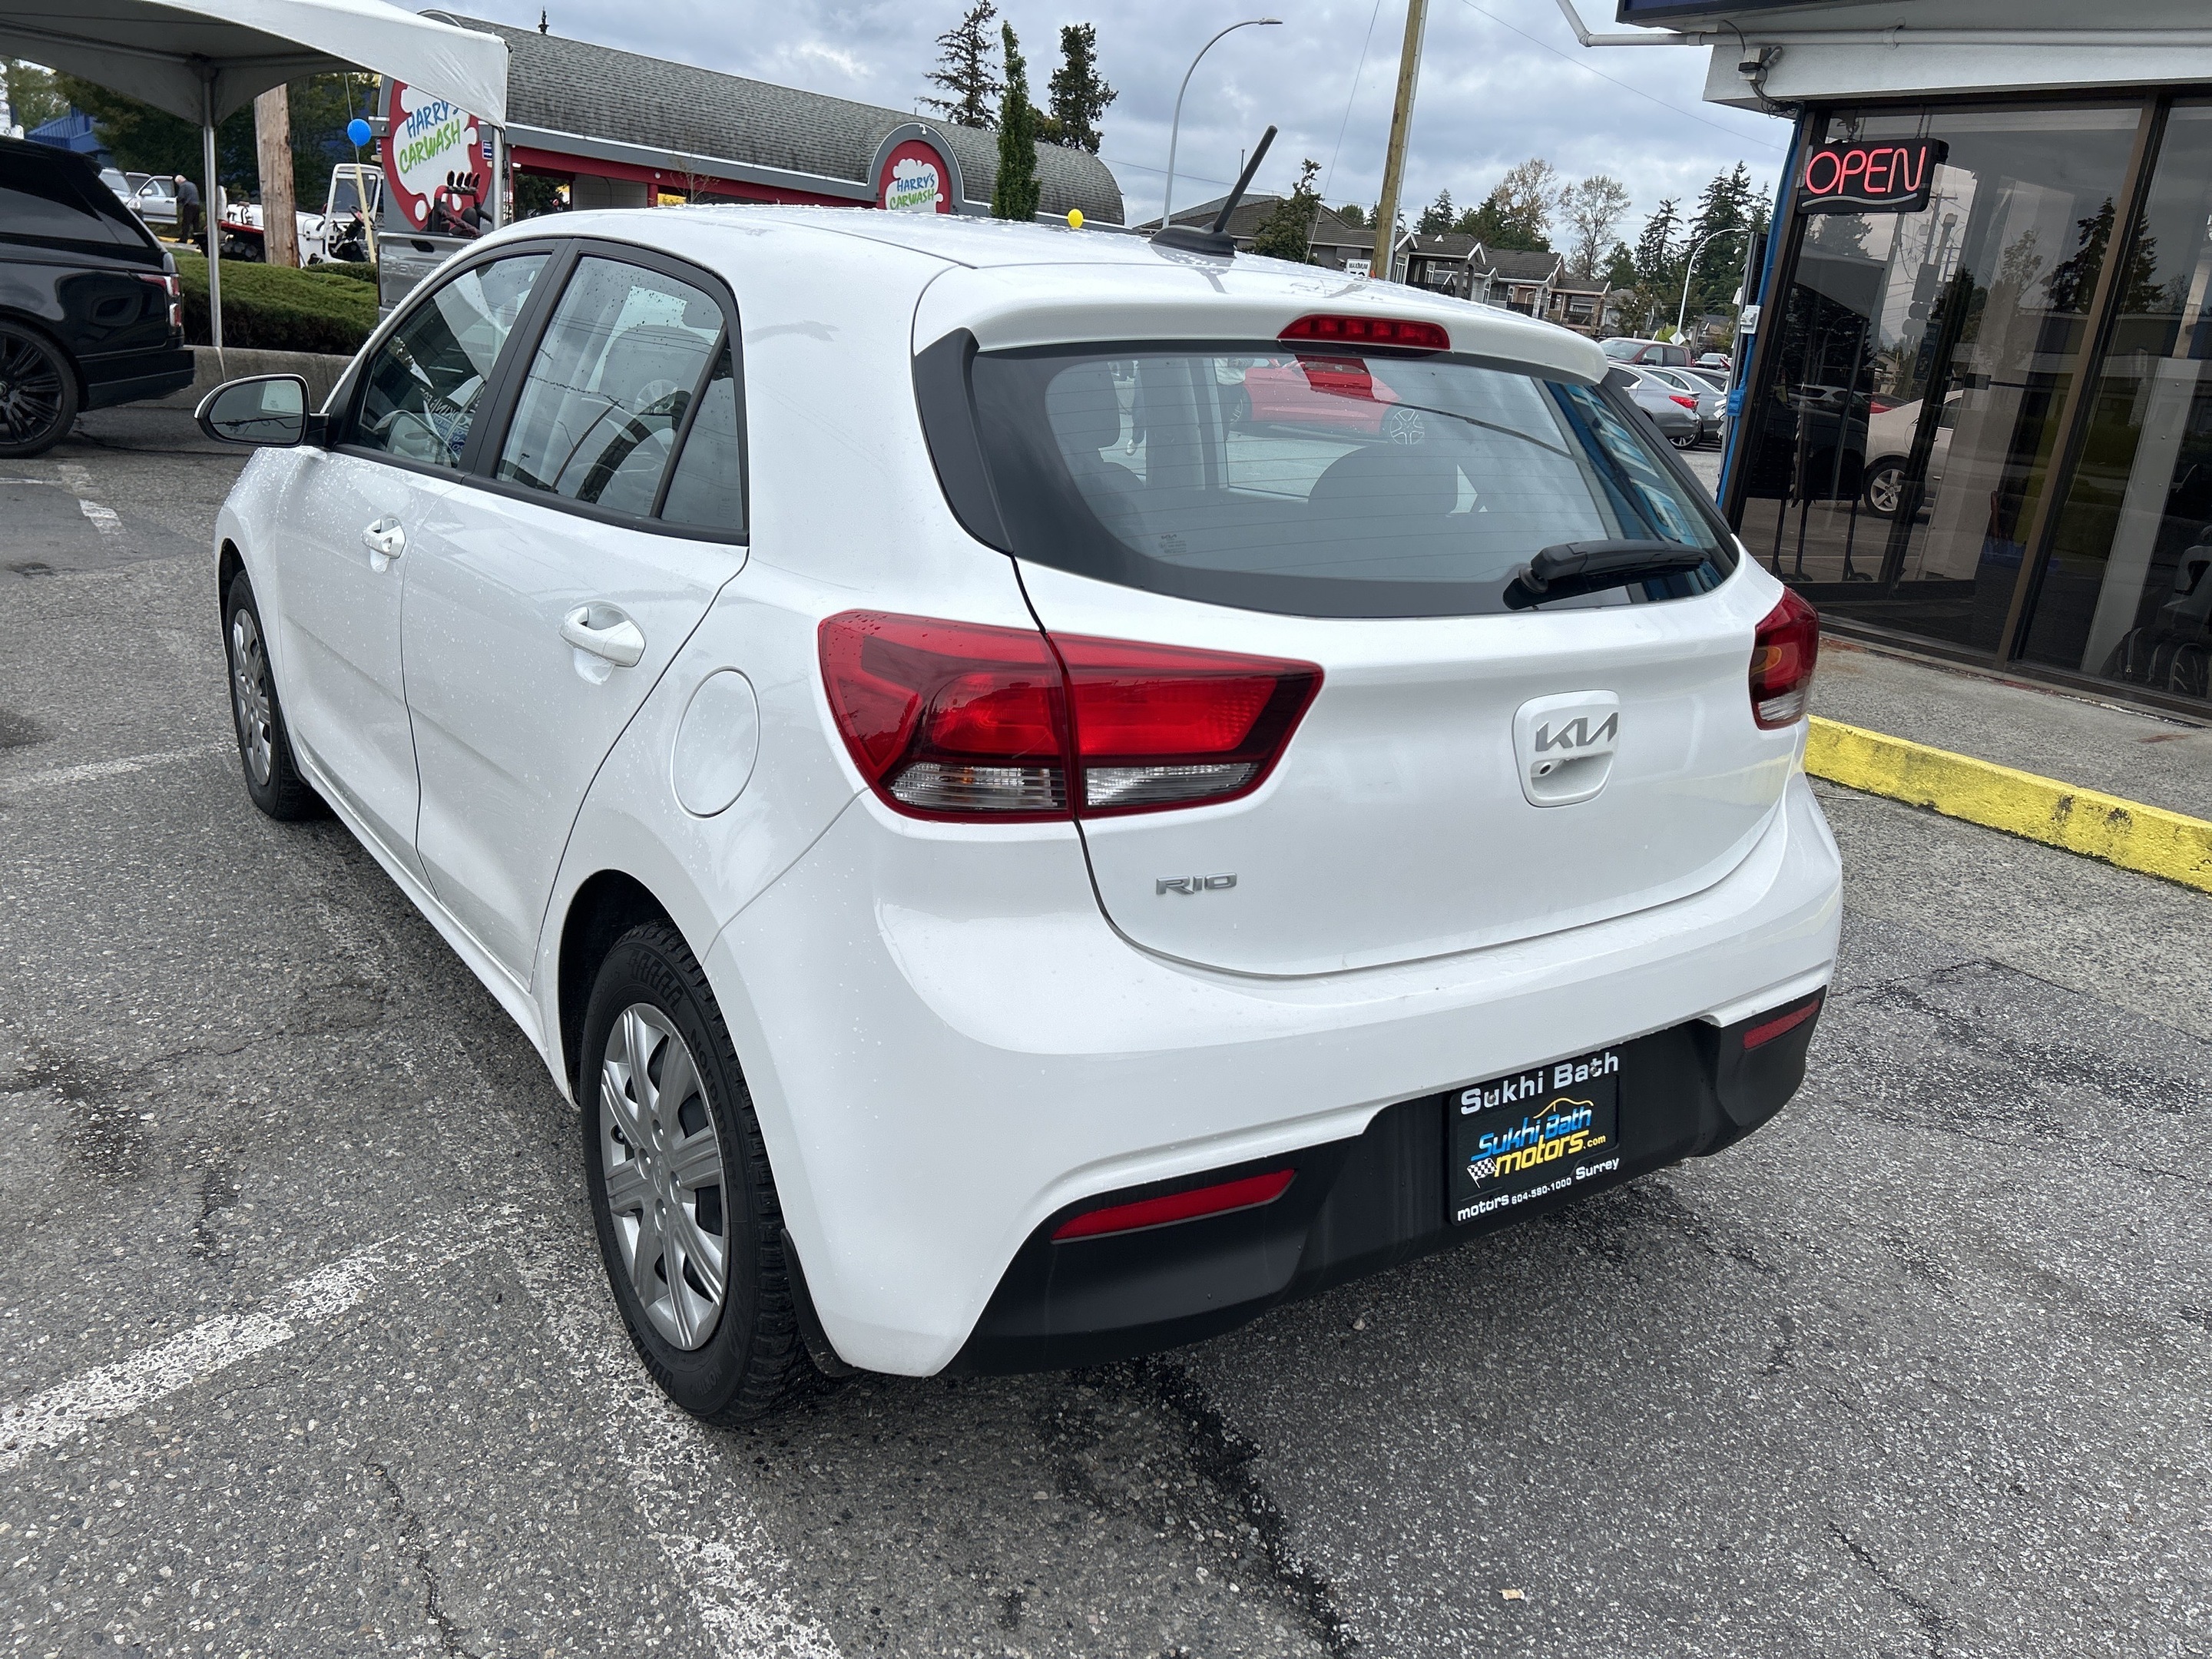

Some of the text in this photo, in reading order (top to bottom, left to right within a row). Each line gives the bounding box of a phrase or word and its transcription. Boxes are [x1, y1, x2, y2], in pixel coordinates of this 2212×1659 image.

[399, 119, 461, 174] CARWASH
[1806, 145, 1926, 194] OPEN
[889, 188, 935, 210] CARWASH
[896, 173, 935, 192] HARRY'S
[1535, 711, 1619, 752] KIA
[1155, 871, 1237, 896] RIO
[1461, 1052, 1619, 1115] Sukhi Bath
[1471, 1106, 1592, 1161] Sukhi Bath
[1457, 1194, 1510, 1221] motors
[1575, 1157, 1621, 1181] Surrey
